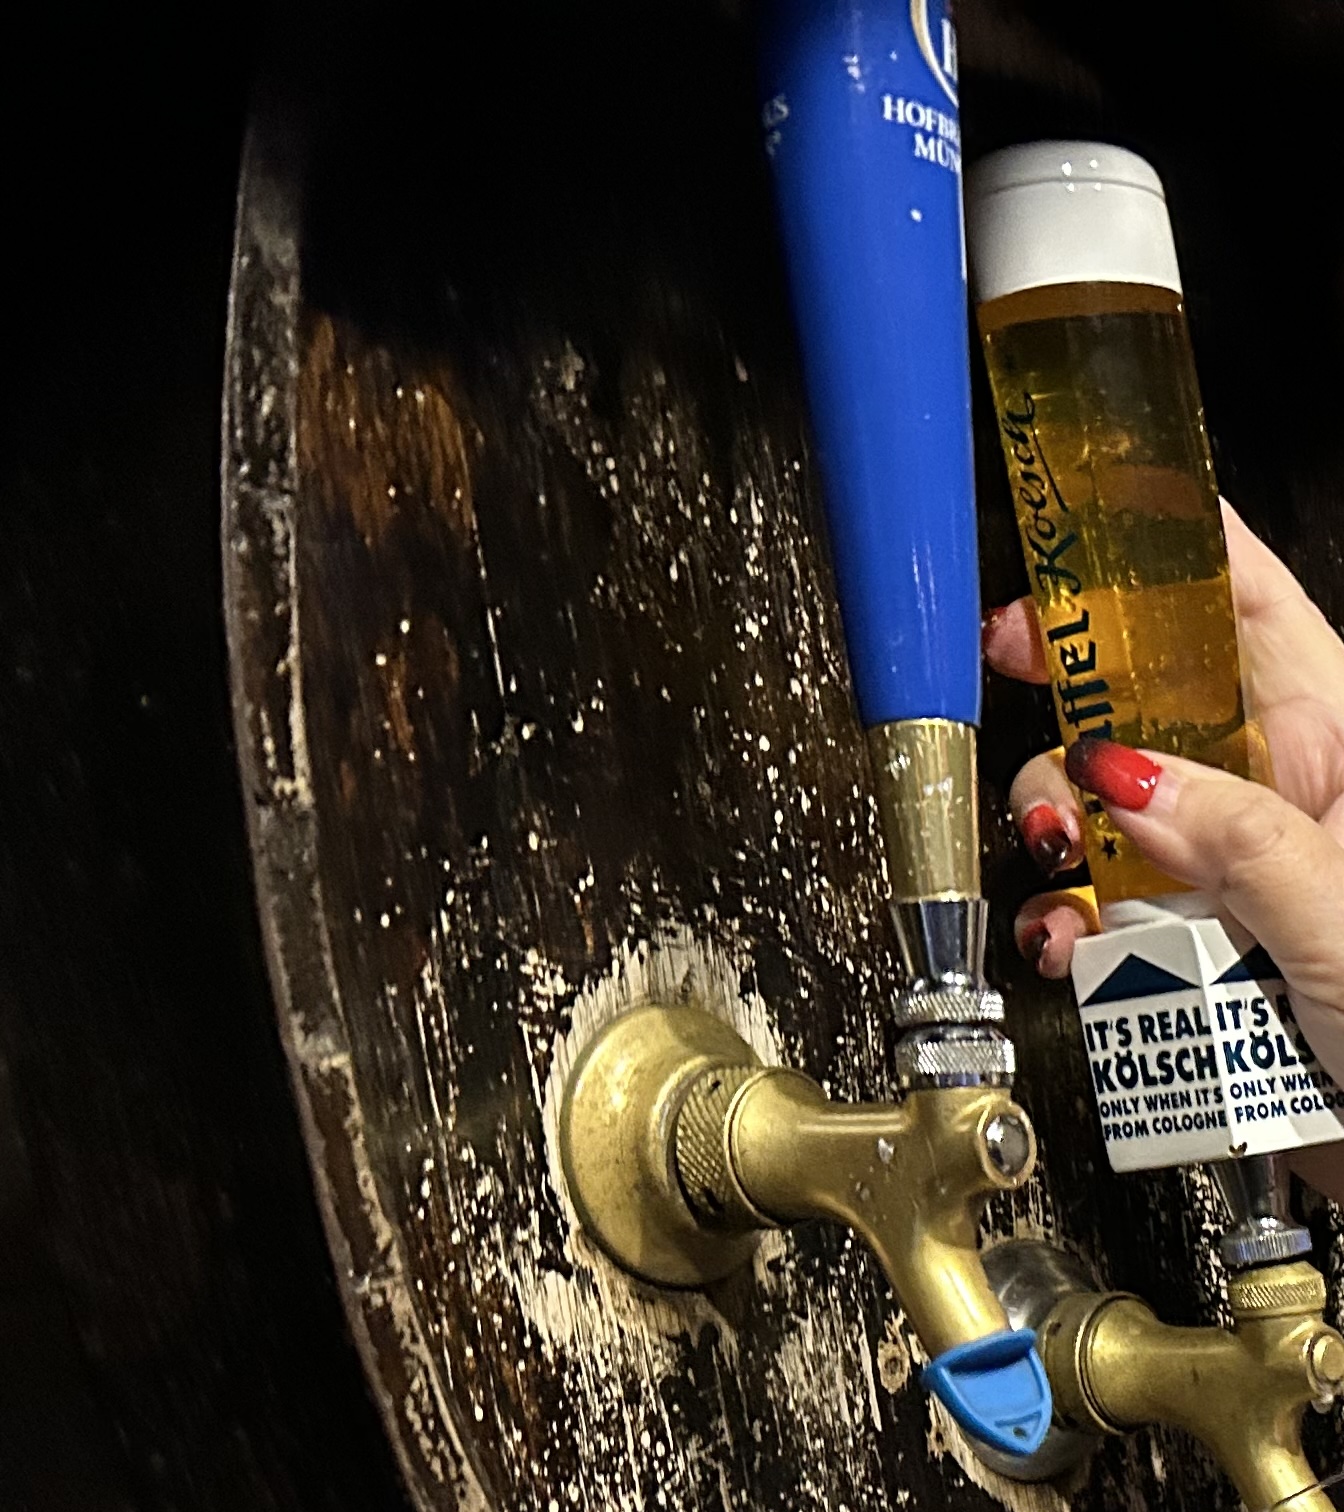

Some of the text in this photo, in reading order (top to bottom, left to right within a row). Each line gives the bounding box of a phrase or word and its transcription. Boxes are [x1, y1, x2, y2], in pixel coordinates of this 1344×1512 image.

[1085, 1006, 1211, 1051] IT'S REAL
[1215, 998, 1269, 1031] IT'S
[1223, 1030, 1315, 1074] KÖLS
[1092, 1044, 1219, 1094] KÖLSCH
[1100, 1085, 1223, 1118] ONLY WHEN IT'S
[1230, 1077, 1276, 1098] ONLY
[1103, 1109, 1227, 1141] FROM COLOGNE
[1235, 1099, 1287, 1124] FROM
